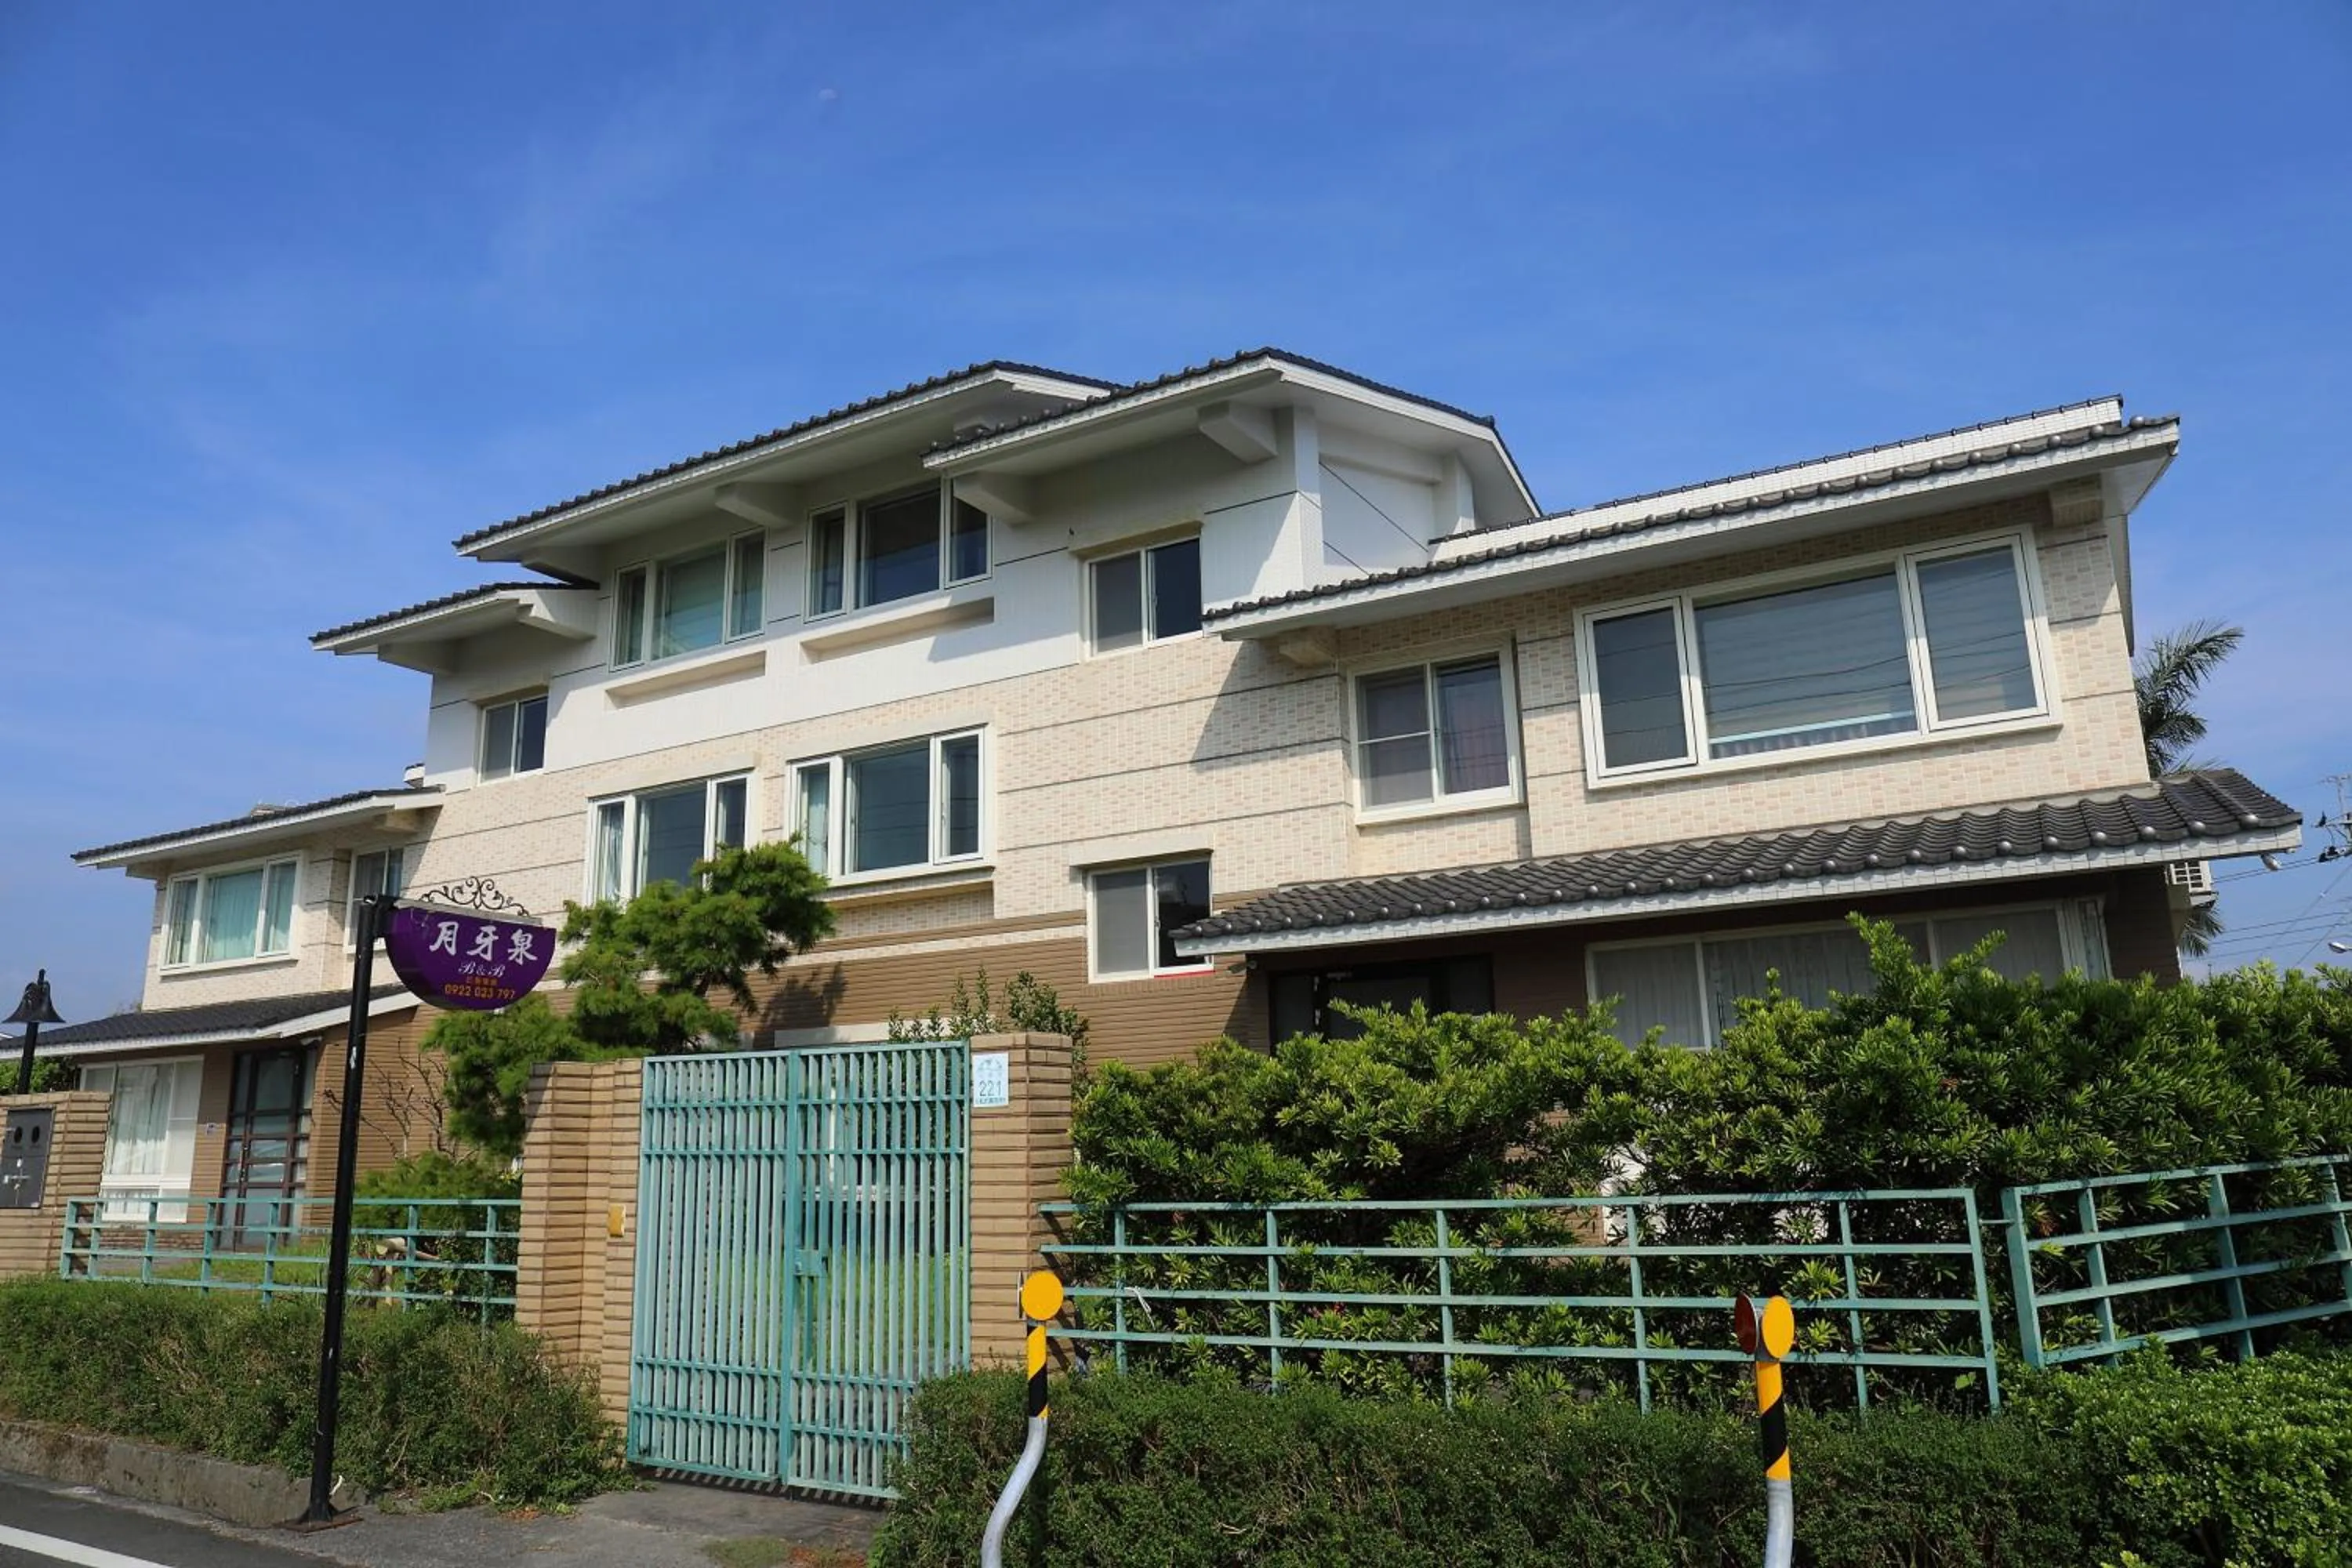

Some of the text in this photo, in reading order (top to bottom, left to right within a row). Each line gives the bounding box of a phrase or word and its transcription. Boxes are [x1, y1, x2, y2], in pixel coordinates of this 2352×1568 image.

[429, 921, 538, 965] 月牙泉
[445, 984, 471, 996] 0922
[496, 988, 515, 1000] 797
[979, 1080, 1001, 1096] 221
